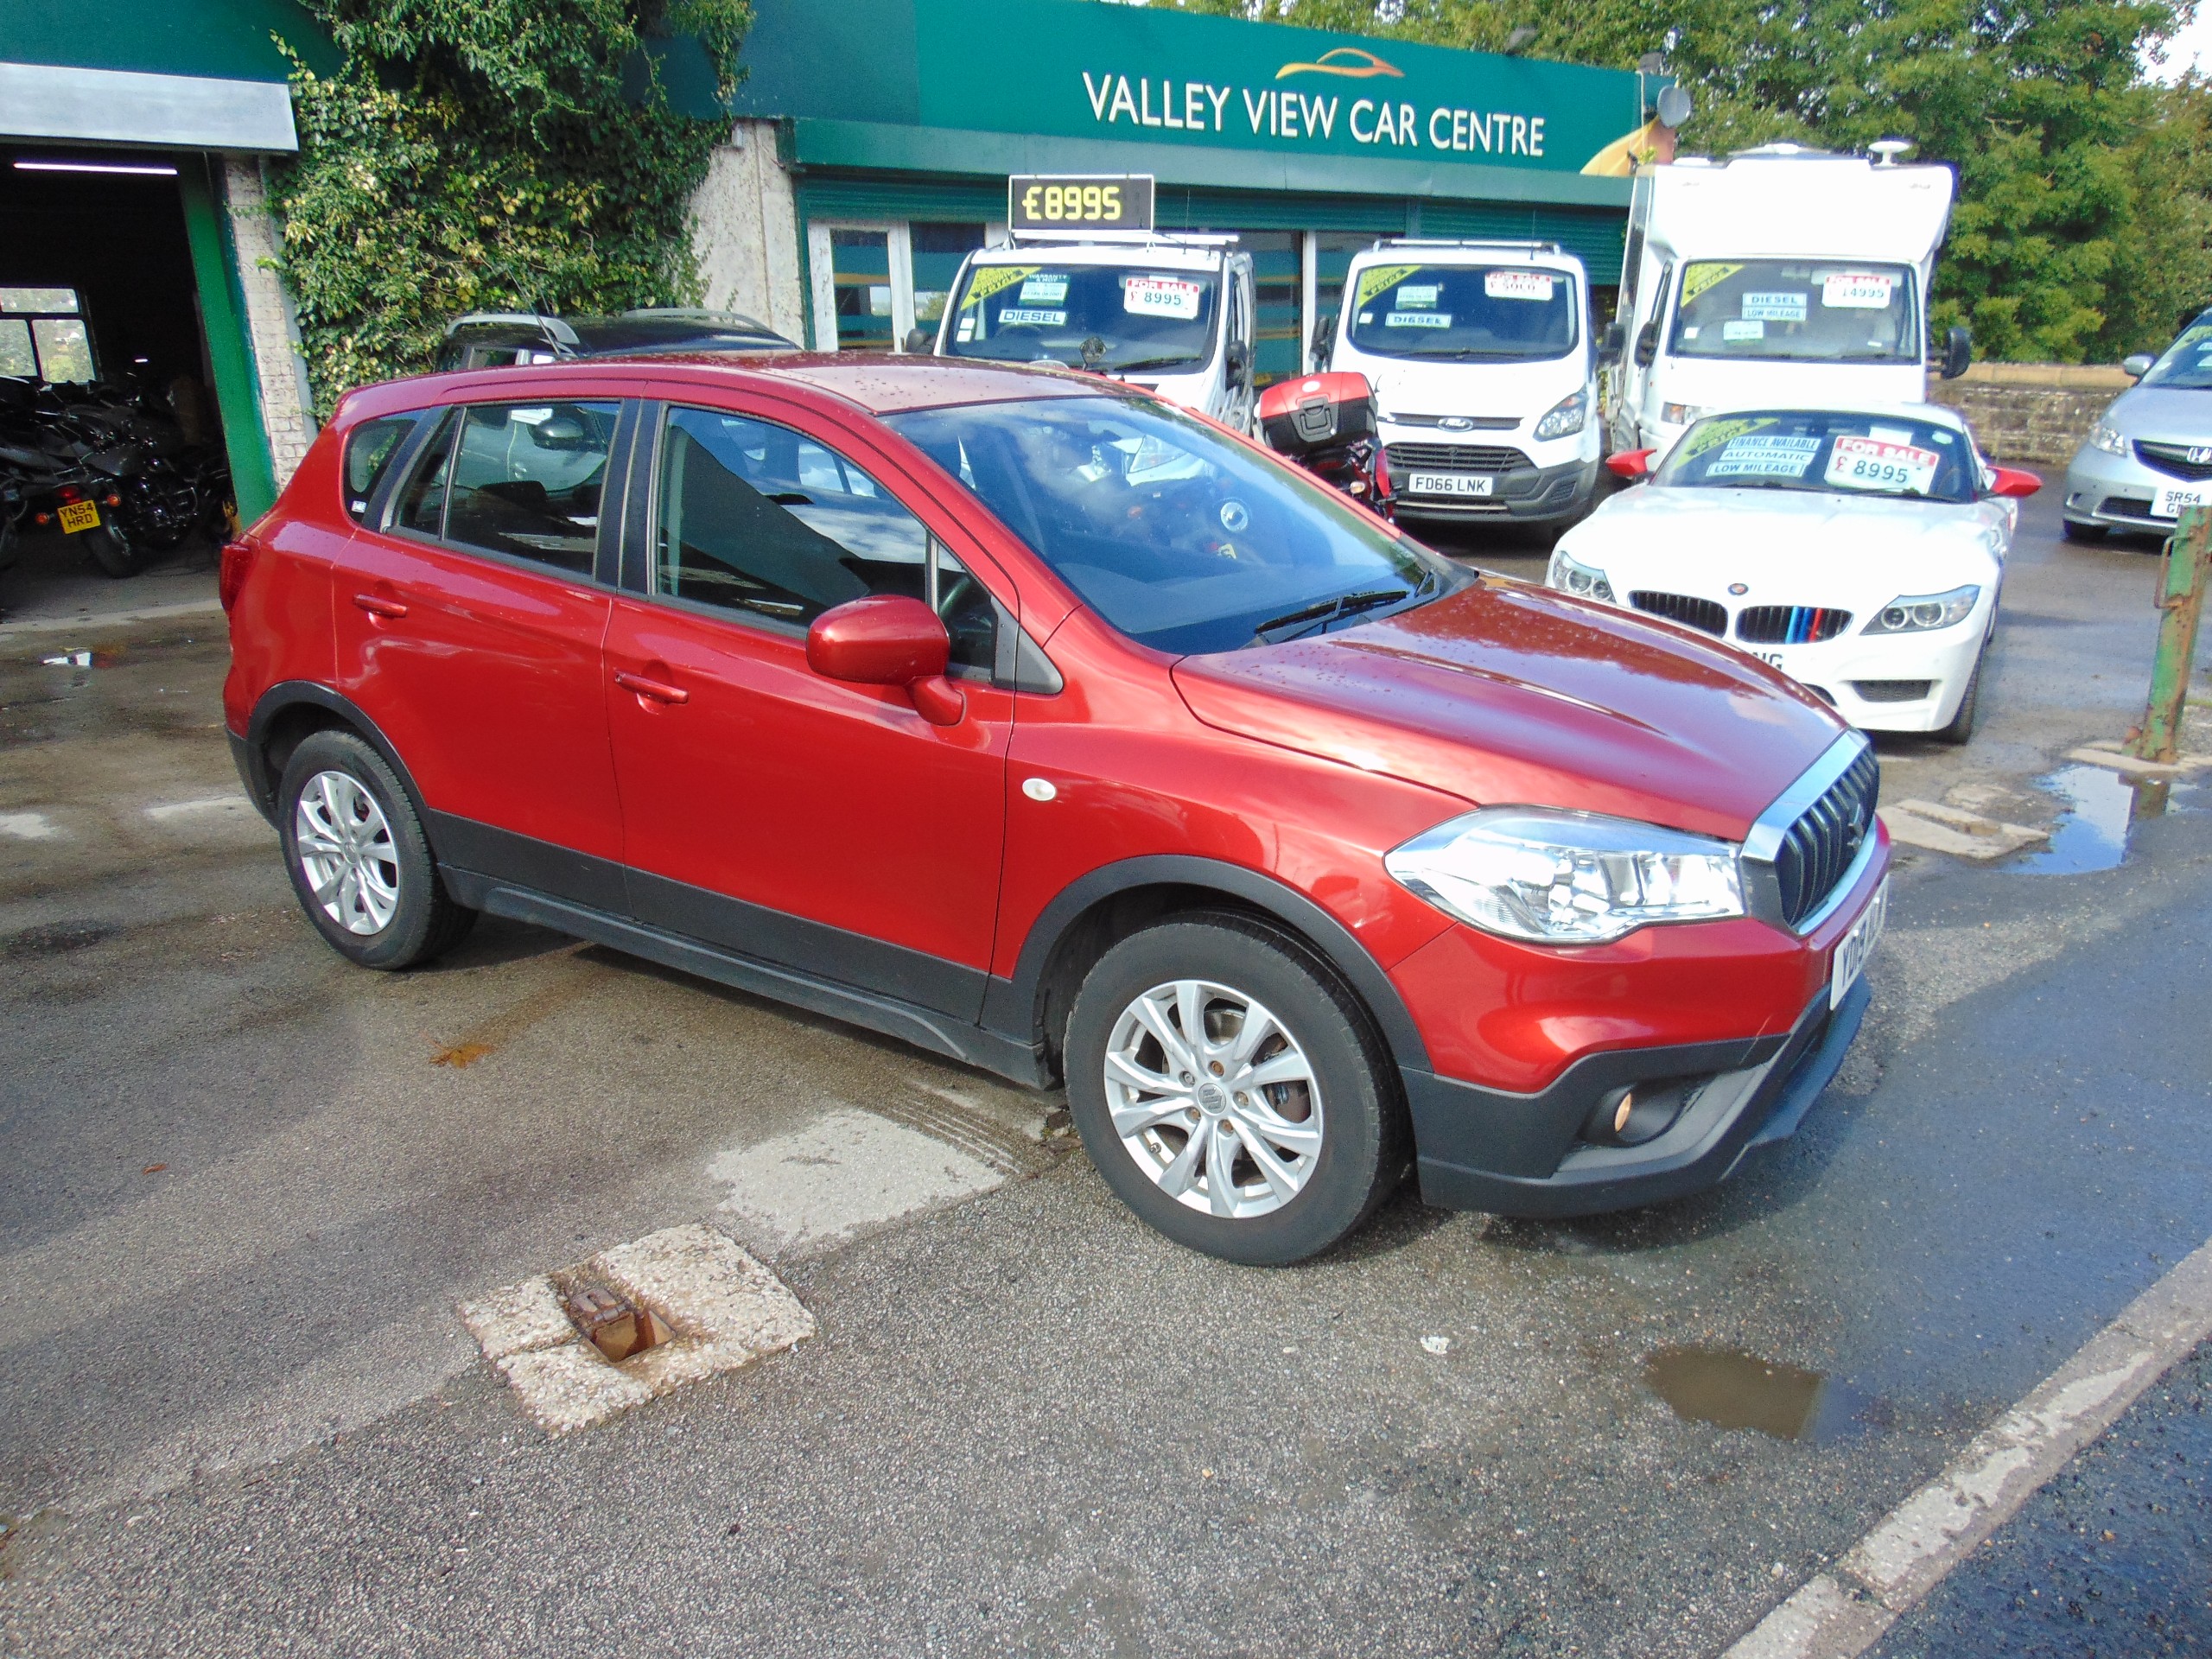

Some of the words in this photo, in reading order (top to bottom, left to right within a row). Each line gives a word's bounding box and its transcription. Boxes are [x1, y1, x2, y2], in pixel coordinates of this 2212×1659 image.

[1082, 72, 1230, 131] VALLEY
[1242, 88, 1338, 140] VIEW
[1349, 99, 1418, 147] CAR
[1428, 107, 1545, 157] CENTRE
[1021, 185, 1121, 221] £8995
[1143, 291, 1182, 306] 8995
[1751, 296, 1798, 305] DIESEL
[1003, 310, 1061, 323] DIESEL
[1393, 315, 1442, 326] DIESEL
[1766, 310, 1802, 319] MILEAGE
[1729, 437, 1769, 448] FINANCE
[1770, 437, 1818, 450] AVAILABLE
[1724, 451, 1811, 461] AUTOMATIC
[1841, 439, 1878, 455] FOR
[1882, 447, 1931, 466] SALE
[1714, 464, 1741, 474] LOW
[1742, 463, 1797, 474] MILEAGE
[1853, 460, 1908, 484] 8995
[1415, 479, 1453, 492] FD66
[1457, 480, 1486, 493] LNK
[2165, 491, 2202, 504] SR54
[60, 503, 94, 518] YN54
[67, 513, 93, 528] HRD
